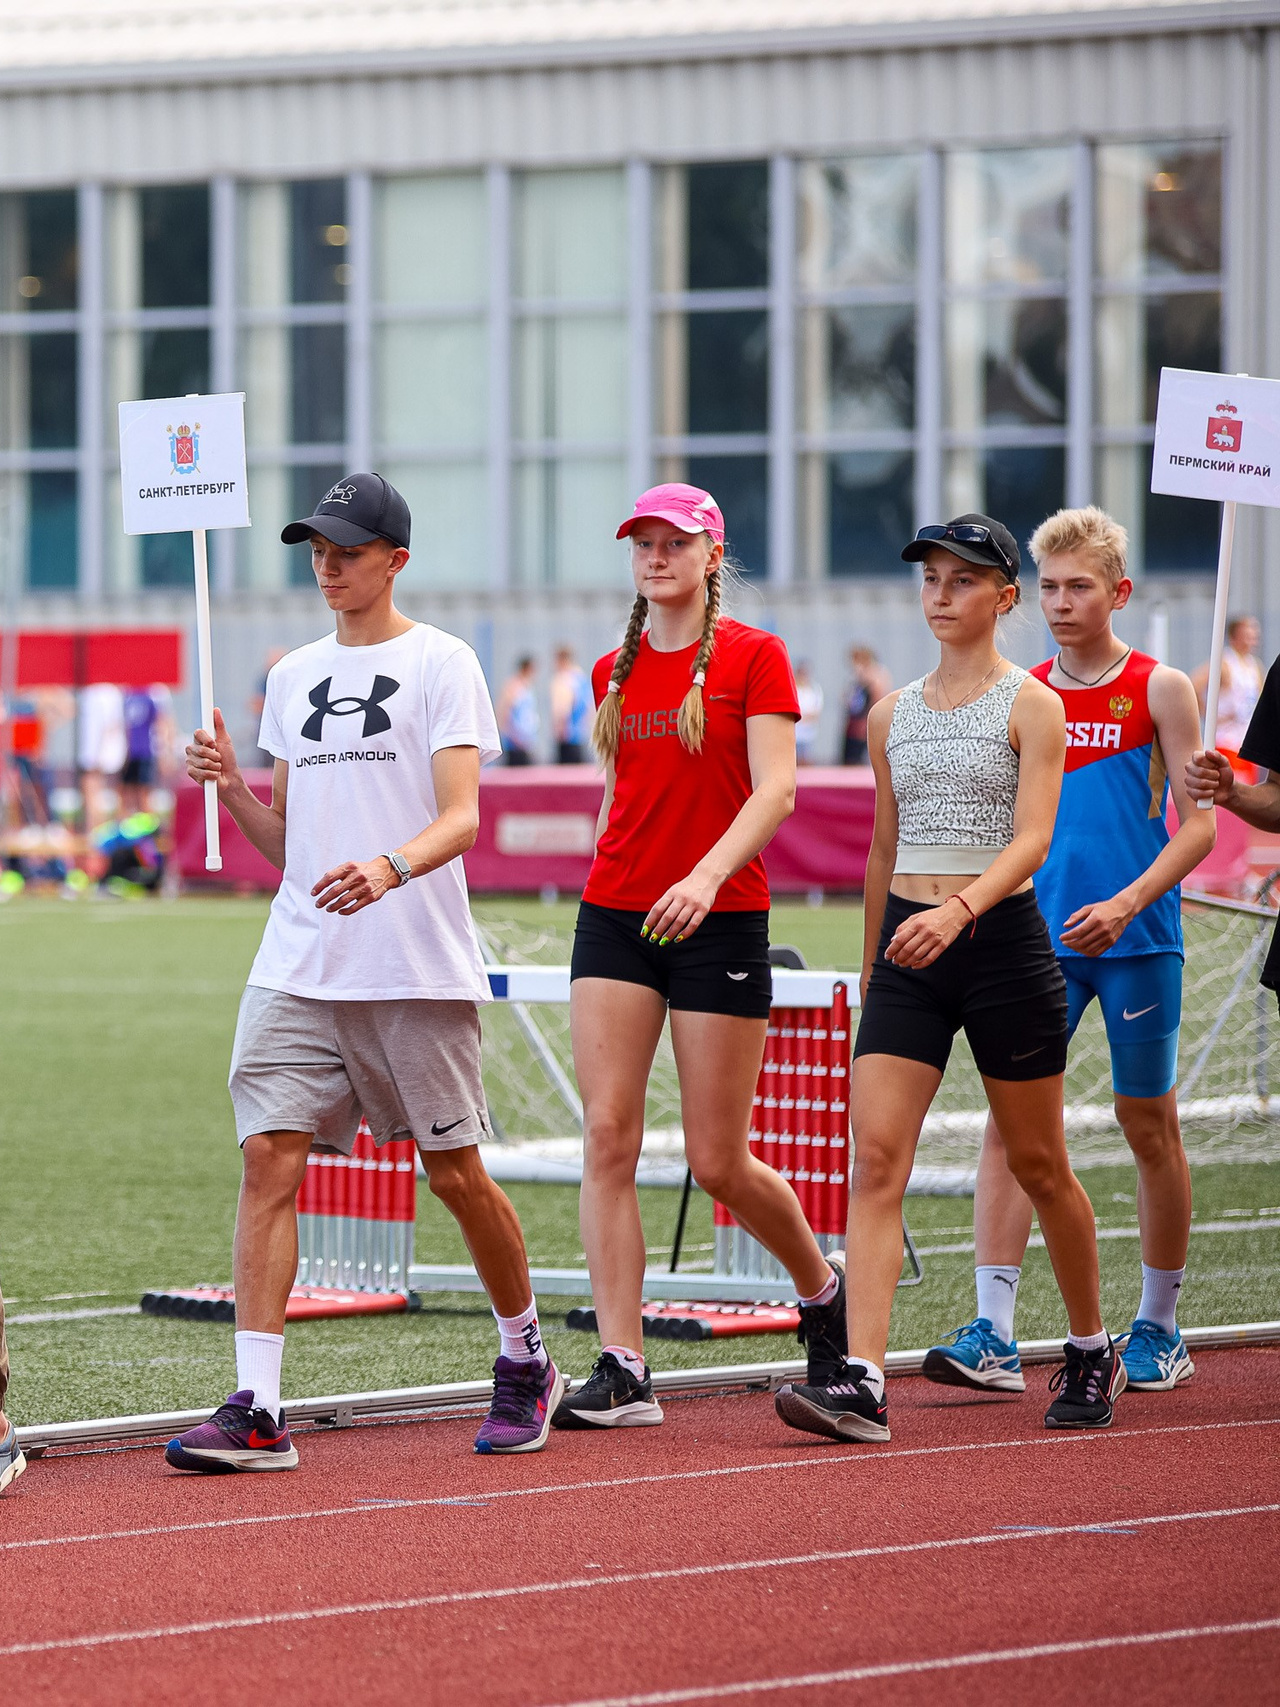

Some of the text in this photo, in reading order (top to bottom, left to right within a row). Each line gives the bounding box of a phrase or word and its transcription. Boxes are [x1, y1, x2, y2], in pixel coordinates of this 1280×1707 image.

[1169, 454, 1271, 478] ПЕРМСКИЙ КРАЙ
[138, 481, 236, 499] САНКТ-ПЕТЕРБУРГ
[621, 707, 709, 742] RUSS
[295, 751, 397, 768] UNDER ARMOUR
[521, 1318, 541, 1355] FILA
